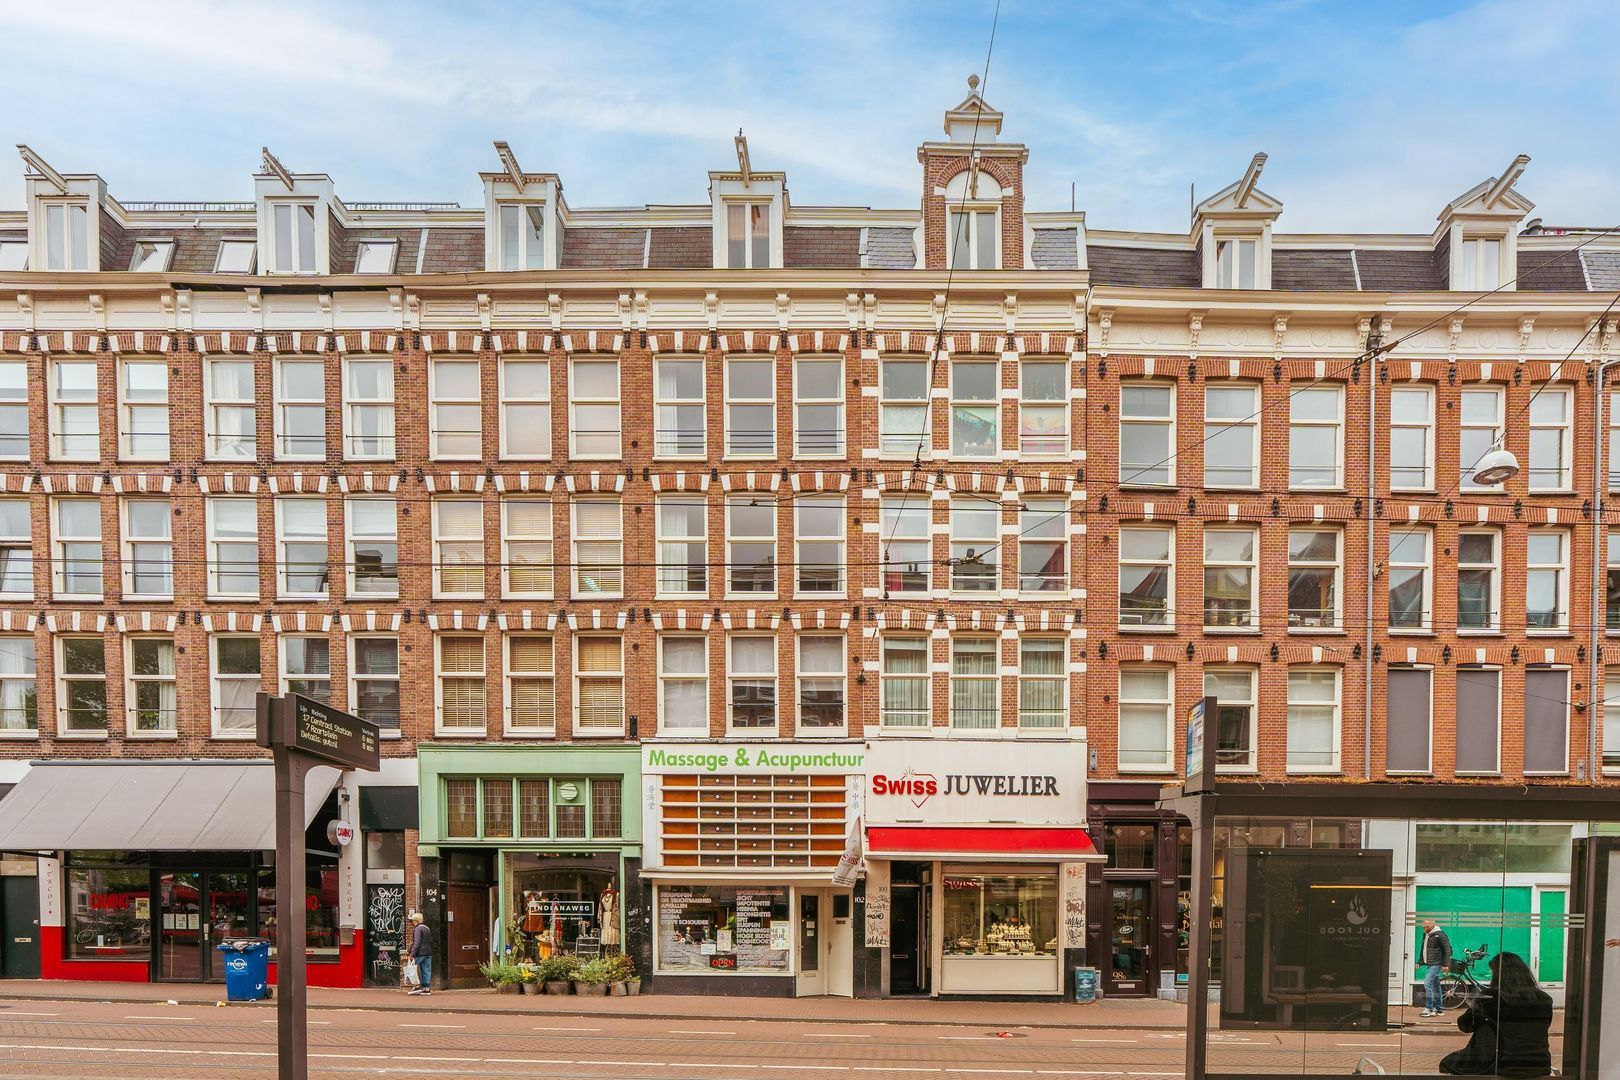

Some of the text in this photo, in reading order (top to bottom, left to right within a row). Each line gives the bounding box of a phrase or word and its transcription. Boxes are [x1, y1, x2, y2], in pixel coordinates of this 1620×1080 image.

[311, 708, 327, 720] Richting
[310, 716, 333, 730] Centraal
[334, 724, 352, 737] Station
[310, 724, 338, 740] Azartplein
[301, 730, 321, 743] Details:
[648, 748, 864, 771] Massage & Acupunctuur
[872, 774, 1060, 796] Swiss JUWELIER
[90, 893, 129, 910] CAMINO
